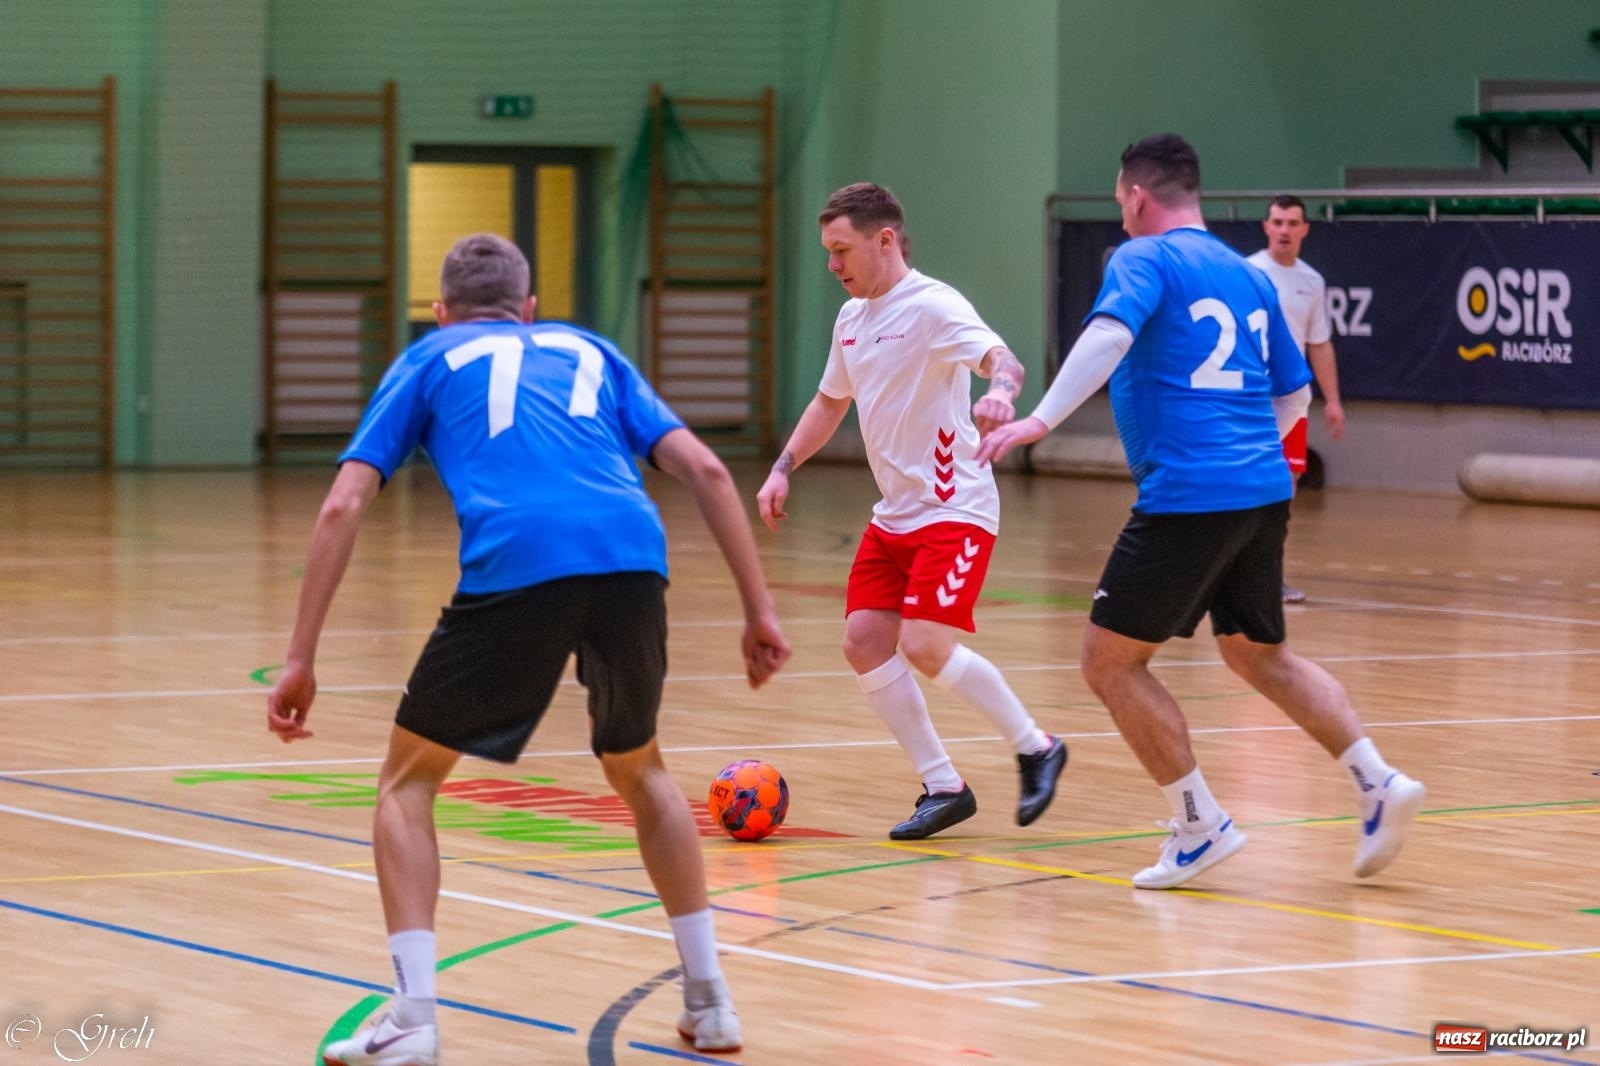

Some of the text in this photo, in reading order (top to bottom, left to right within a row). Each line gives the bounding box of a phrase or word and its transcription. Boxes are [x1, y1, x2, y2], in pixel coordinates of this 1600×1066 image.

[1326, 287, 1373, 337] RZ
[1457, 266, 1572, 338] OSiR
[1188, 297, 1269, 389] 21
[1502, 338, 1572, 364] RACIBÓRZ
[443, 332, 605, 440] 77
